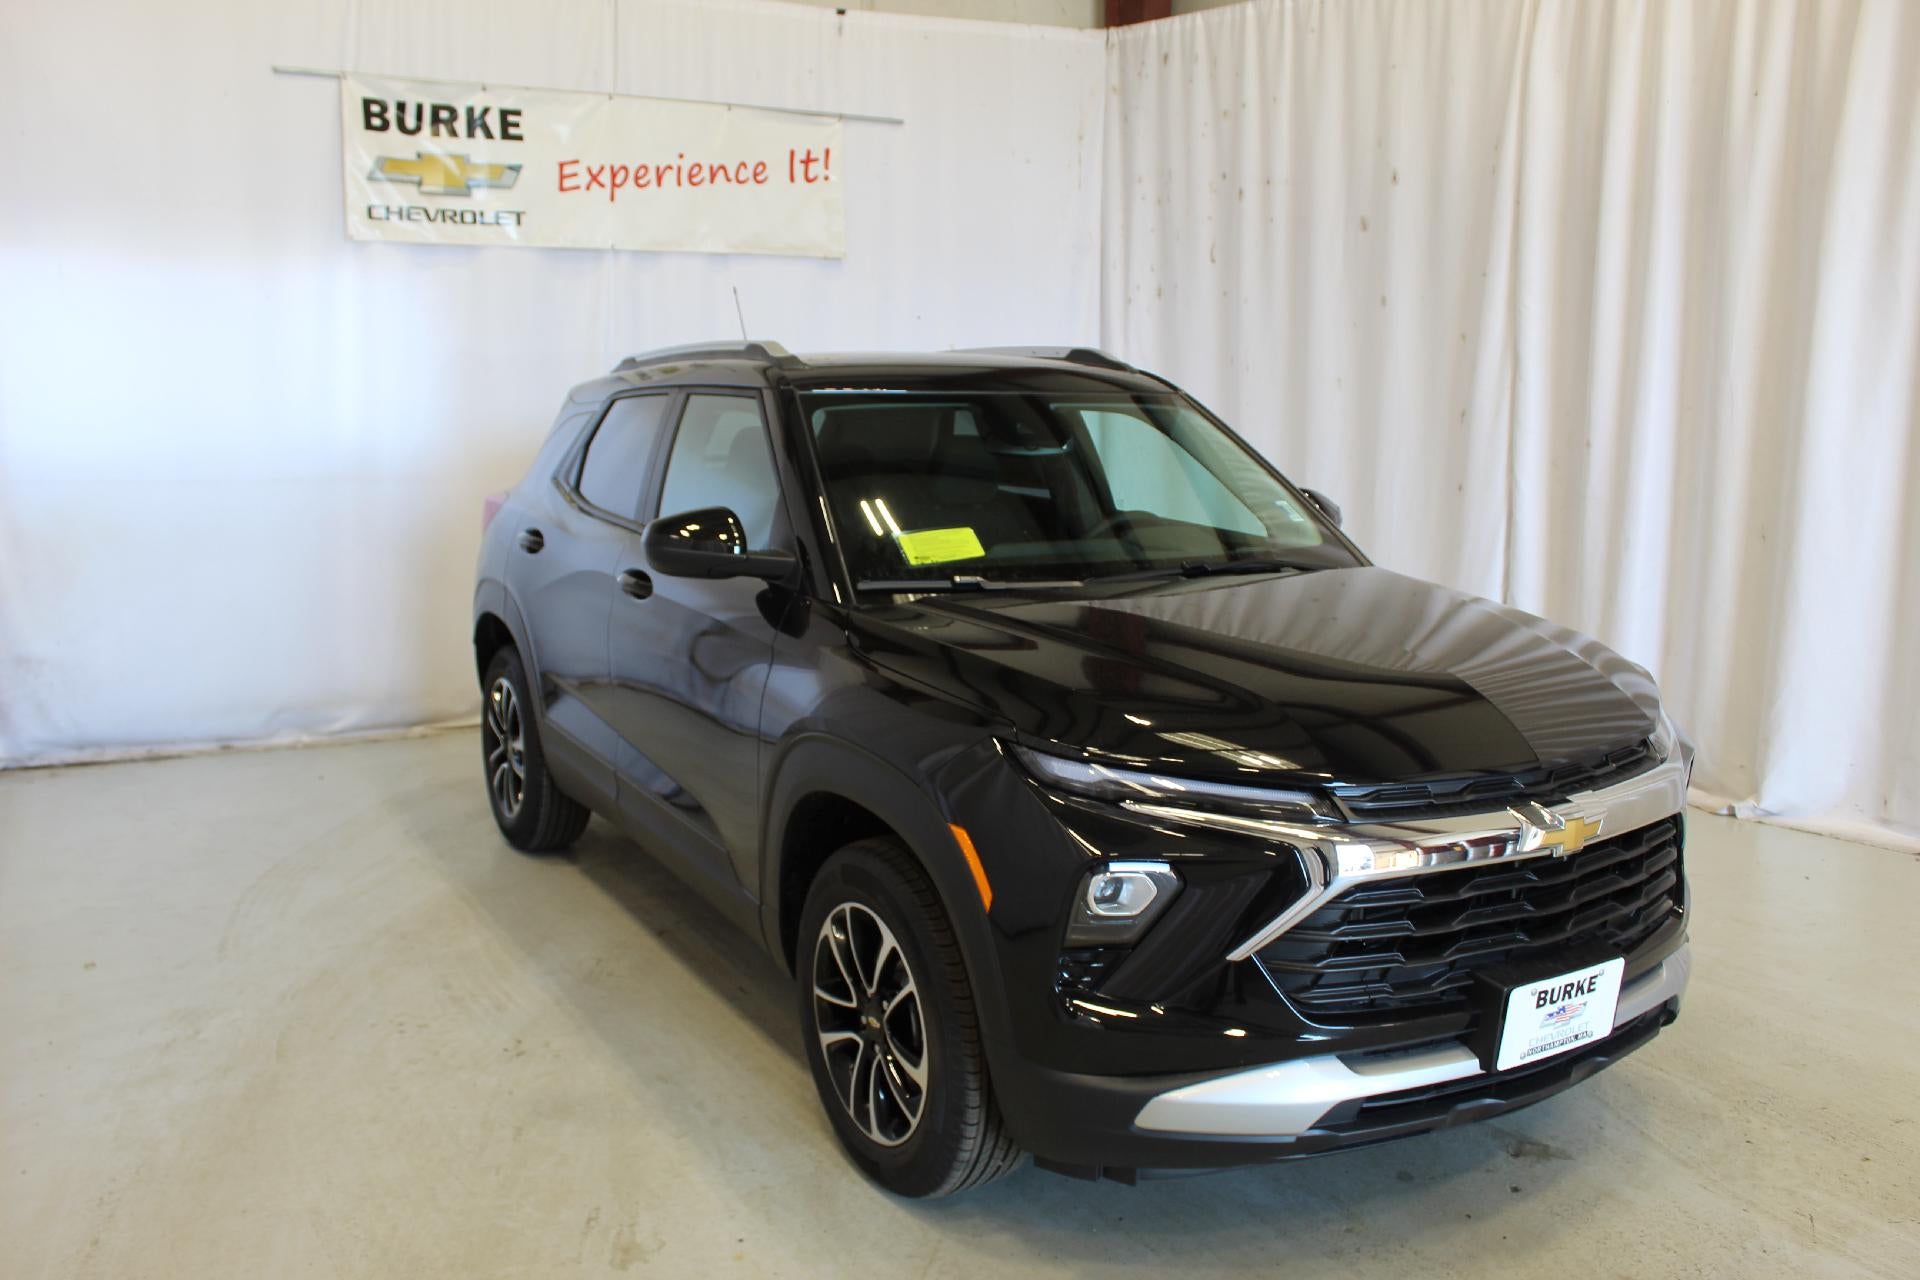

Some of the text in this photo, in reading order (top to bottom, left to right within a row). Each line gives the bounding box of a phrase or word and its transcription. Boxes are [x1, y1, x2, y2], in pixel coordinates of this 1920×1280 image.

[362, 96, 524, 141] BURKE
[557, 147, 831, 203] Experience It!
[367, 204, 526, 226] CHEVROLET
[1535, 974, 1599, 1009] BURKE
